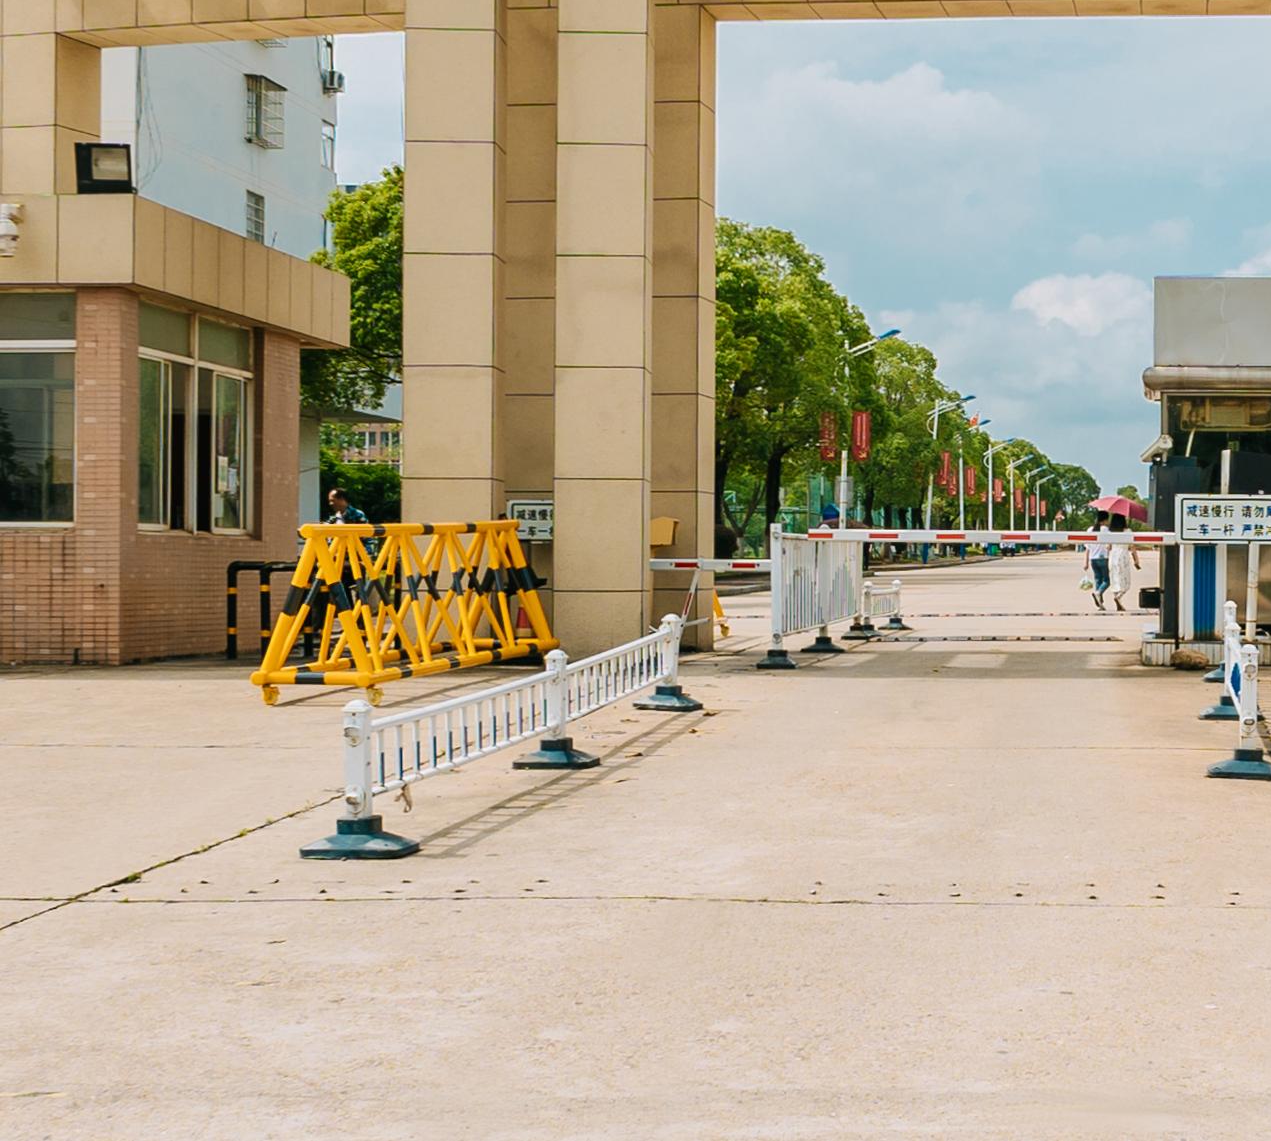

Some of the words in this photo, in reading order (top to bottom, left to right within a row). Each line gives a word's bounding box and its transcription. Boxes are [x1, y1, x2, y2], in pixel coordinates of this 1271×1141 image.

[1186, 504, 1235, 518] 减速慢行
[1186, 523, 1235, 536] 一车一杆
